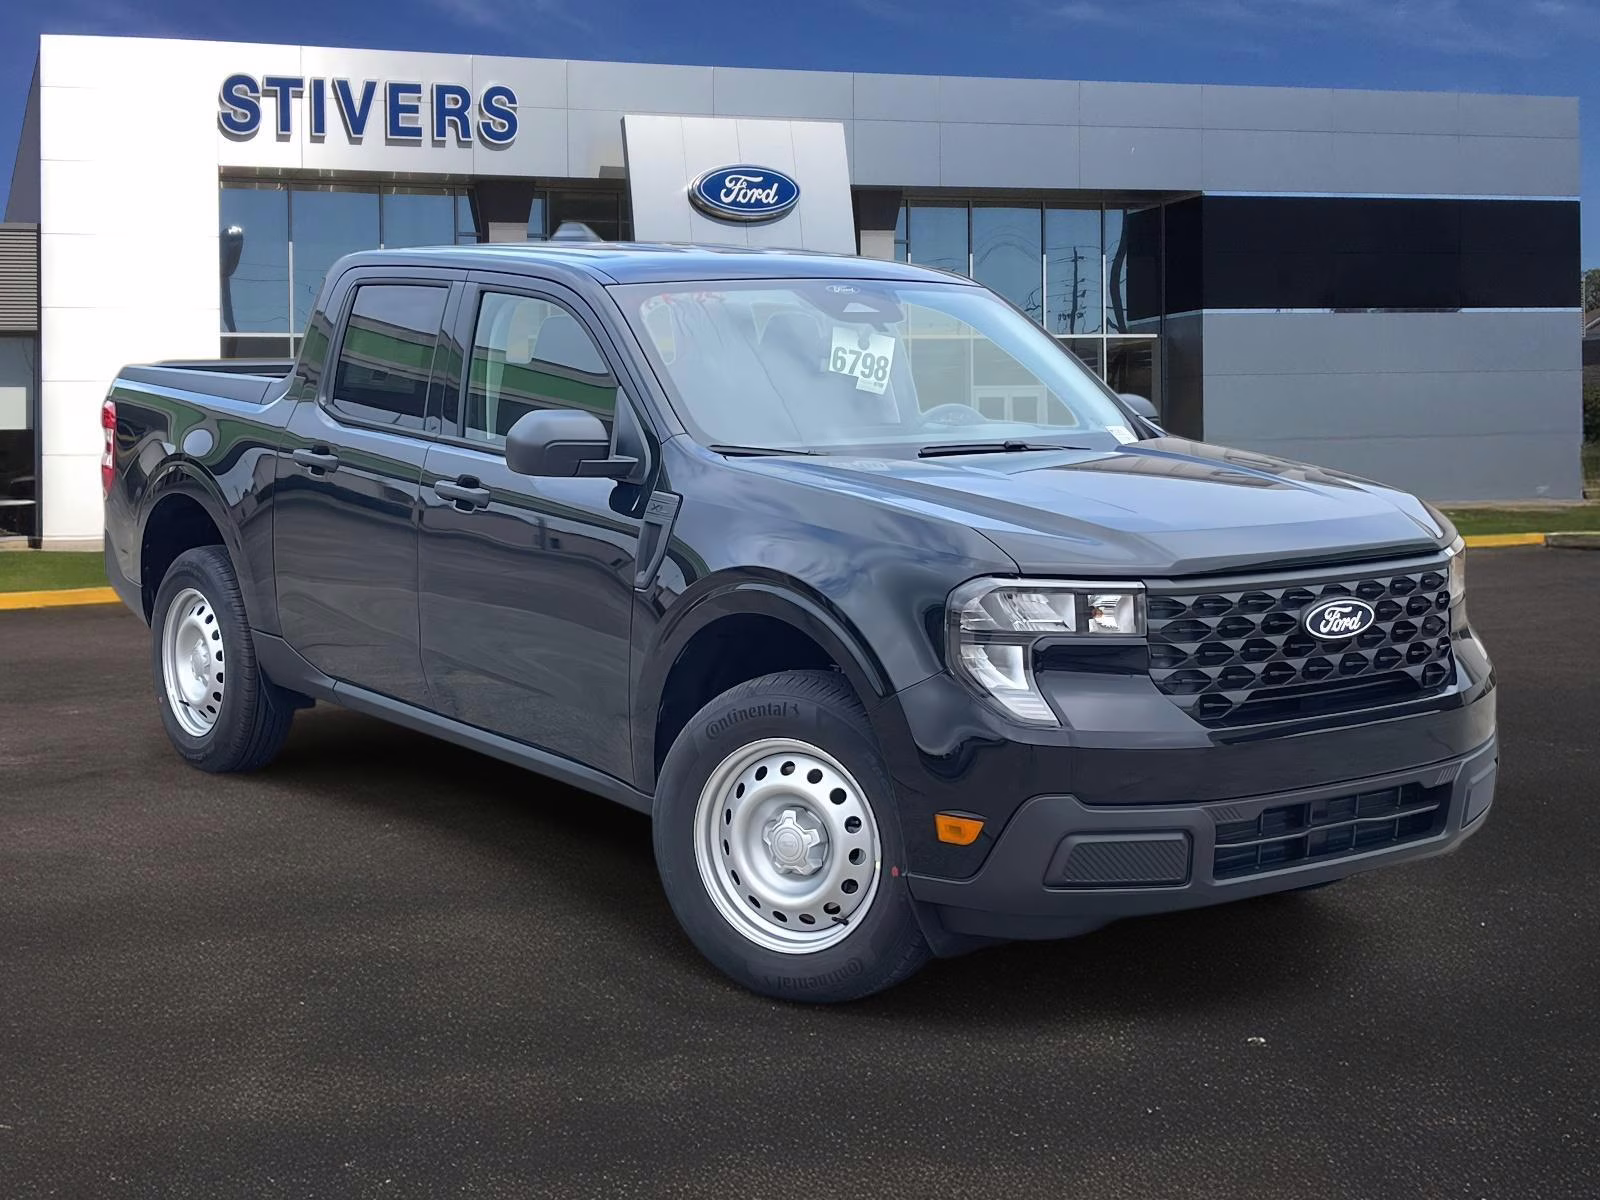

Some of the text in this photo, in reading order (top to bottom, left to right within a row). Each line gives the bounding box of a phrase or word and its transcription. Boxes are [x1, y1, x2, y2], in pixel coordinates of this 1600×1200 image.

[218, 73, 518, 145] STIVERS
[720, 175, 778, 203] Ford
[832, 347, 889, 381] 6798
[1320, 606, 1362, 633] Ford
[705, 702, 787, 740] Continental
